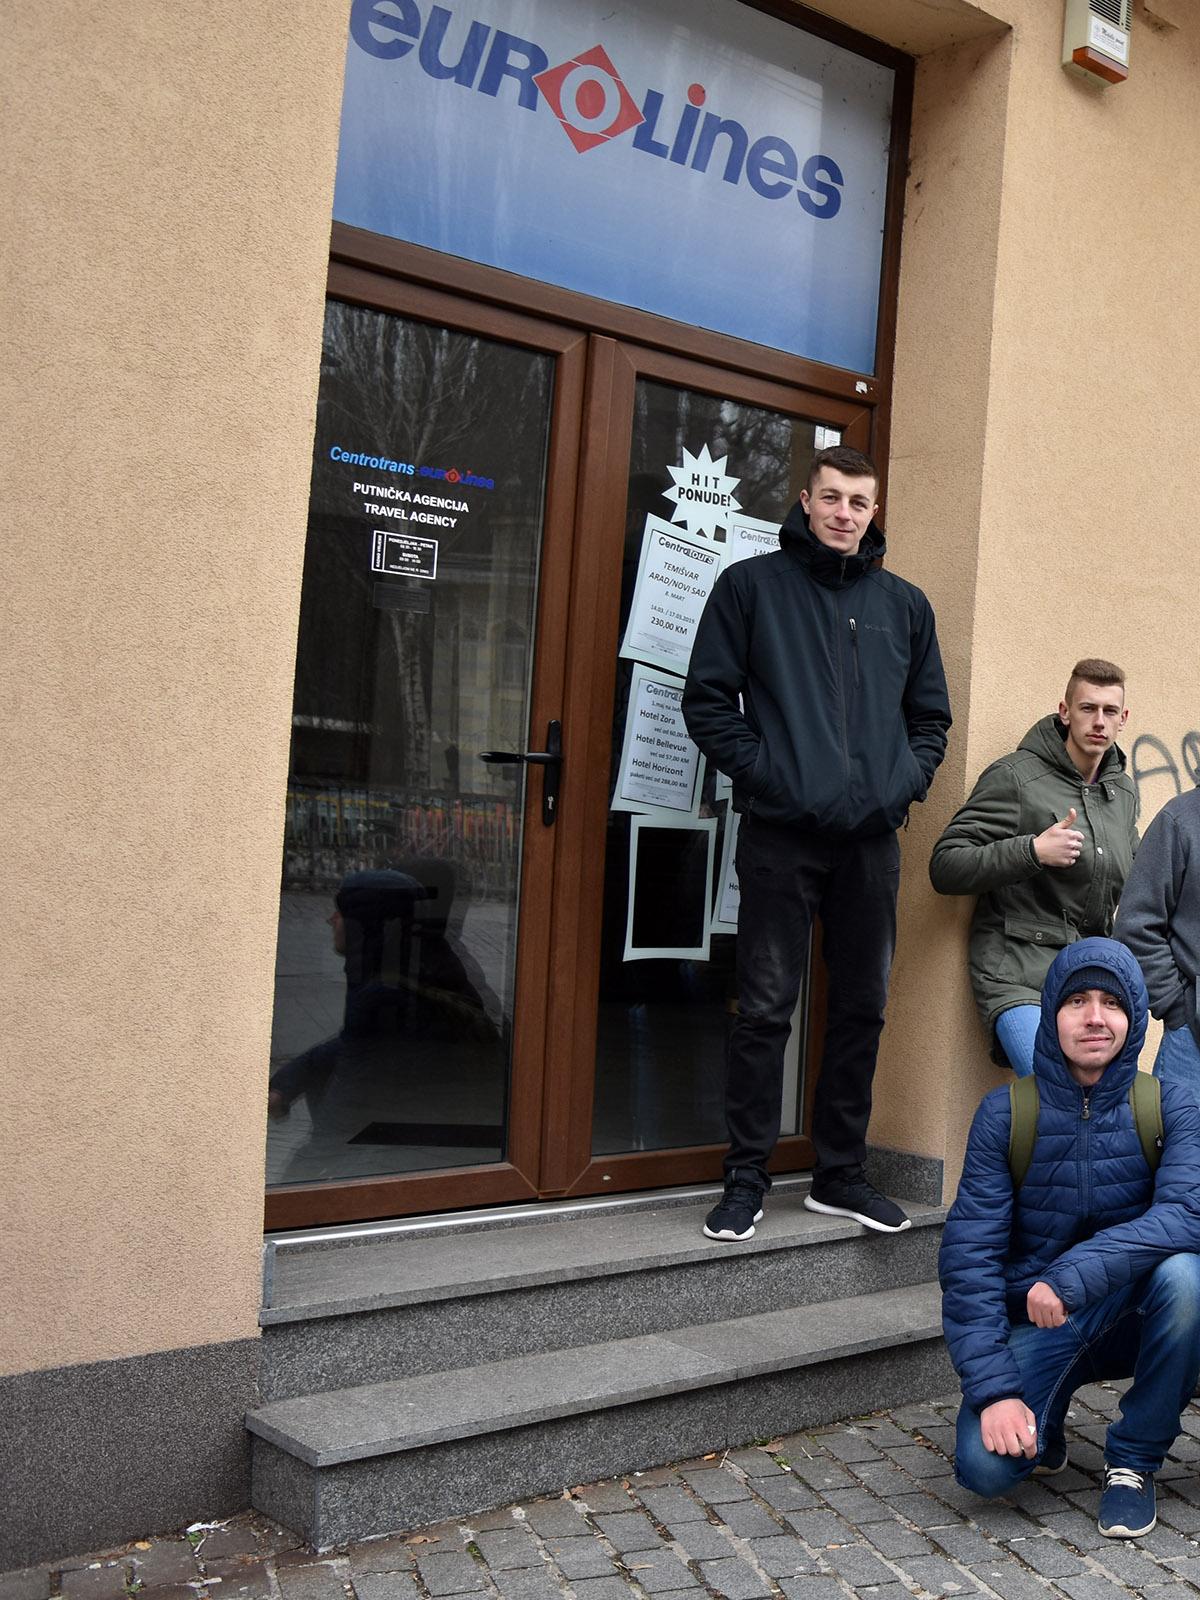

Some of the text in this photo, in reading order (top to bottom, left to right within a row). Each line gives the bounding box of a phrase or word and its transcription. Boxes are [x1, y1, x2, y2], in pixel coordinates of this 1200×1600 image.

[330, 446, 416, 476] Centrotrans
[353, 482, 470, 513] PUTNIČKA AGENCIJA
[678, 487, 731, 507] PONUDE!
[364, 502, 457, 529] TRAVEL AGENCY
[663, 562, 699, 580] TEMIŠVAR
[649, 572, 707, 598] ARAD/NOVI SAD
[650, 616, 675, 631] 230,00
[639, 709, 676, 726] Hotel Zora
[635, 733, 688, 753] Hotel Bellevue
[632, 758, 684, 777] Hotel Horizont
